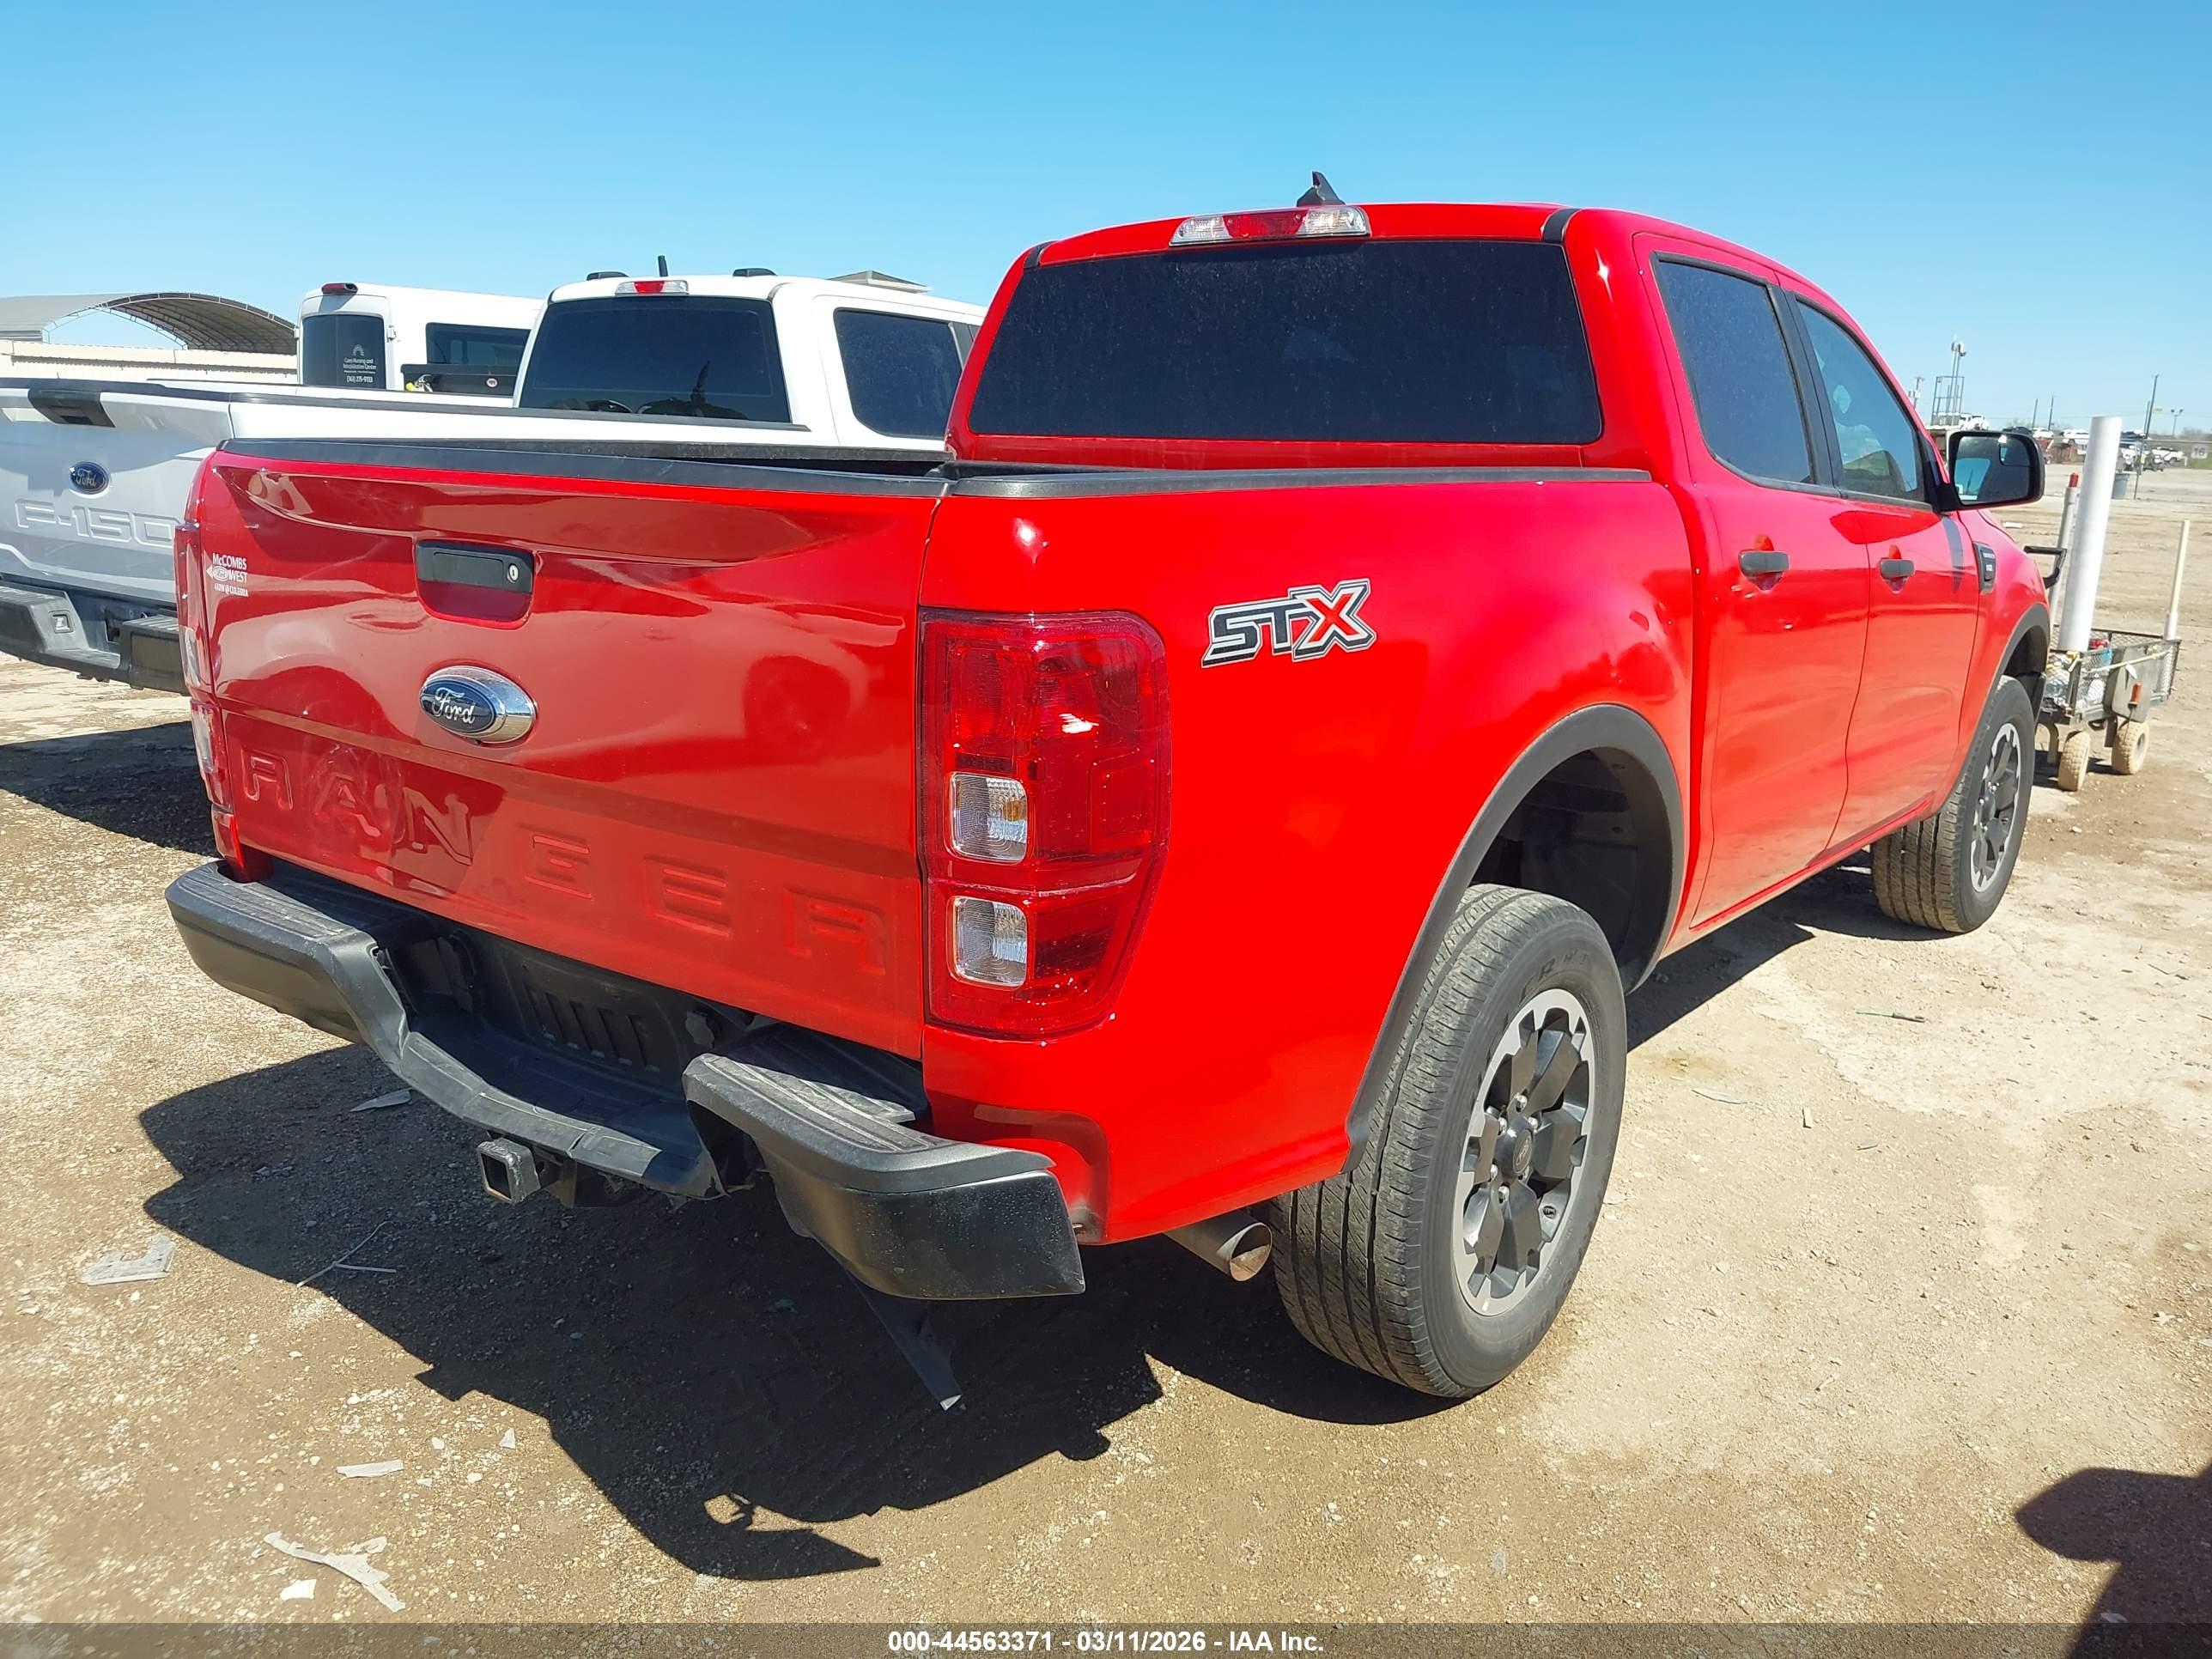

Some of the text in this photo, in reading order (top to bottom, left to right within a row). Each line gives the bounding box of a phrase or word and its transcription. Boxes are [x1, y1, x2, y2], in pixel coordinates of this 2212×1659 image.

[76, 468, 97, 488] Ford
[212, 552, 247, 570] McCOMBS
[228, 569, 247, 583] WEST
[1201, 578, 1376, 668] STX
[432, 687, 476, 724] Ford
[240, 745, 888, 975] RANGER
